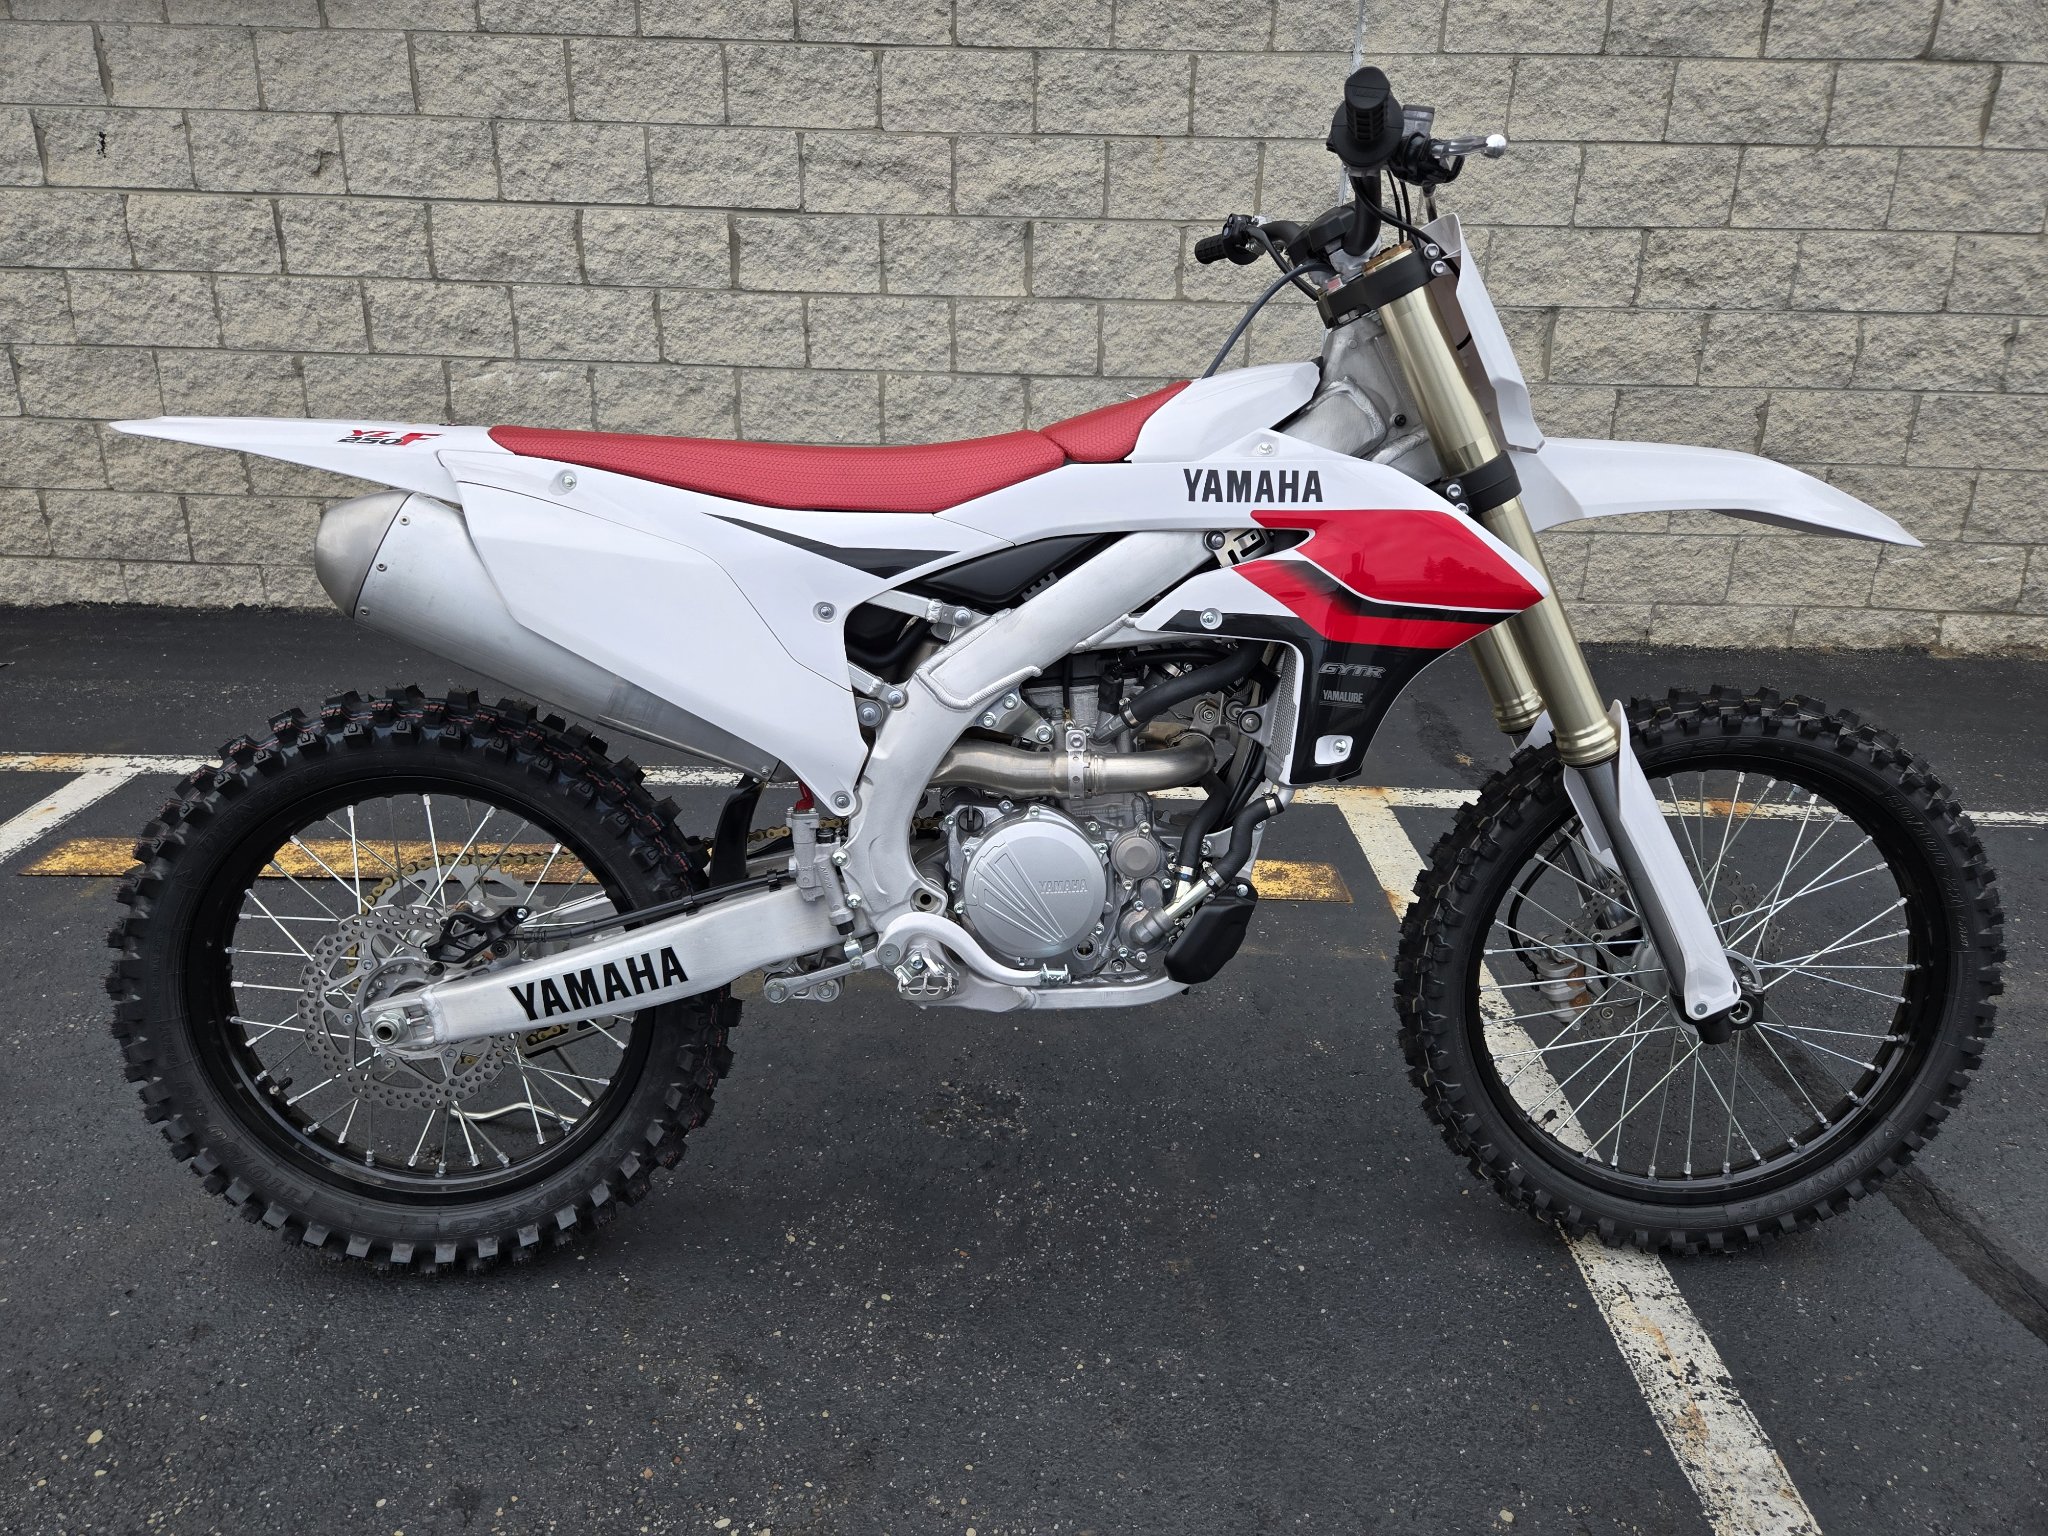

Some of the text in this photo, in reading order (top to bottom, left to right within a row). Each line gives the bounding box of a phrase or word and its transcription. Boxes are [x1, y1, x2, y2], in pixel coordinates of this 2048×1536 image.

[1183, 468, 1323, 502] YAMAHA
[1318, 662, 1387, 679] GYTR
[1323, 689, 1364, 704] YAMALUBE
[1039, 879, 1088, 895] YAMAHA
[509, 946, 689, 1021] YAMAHA
